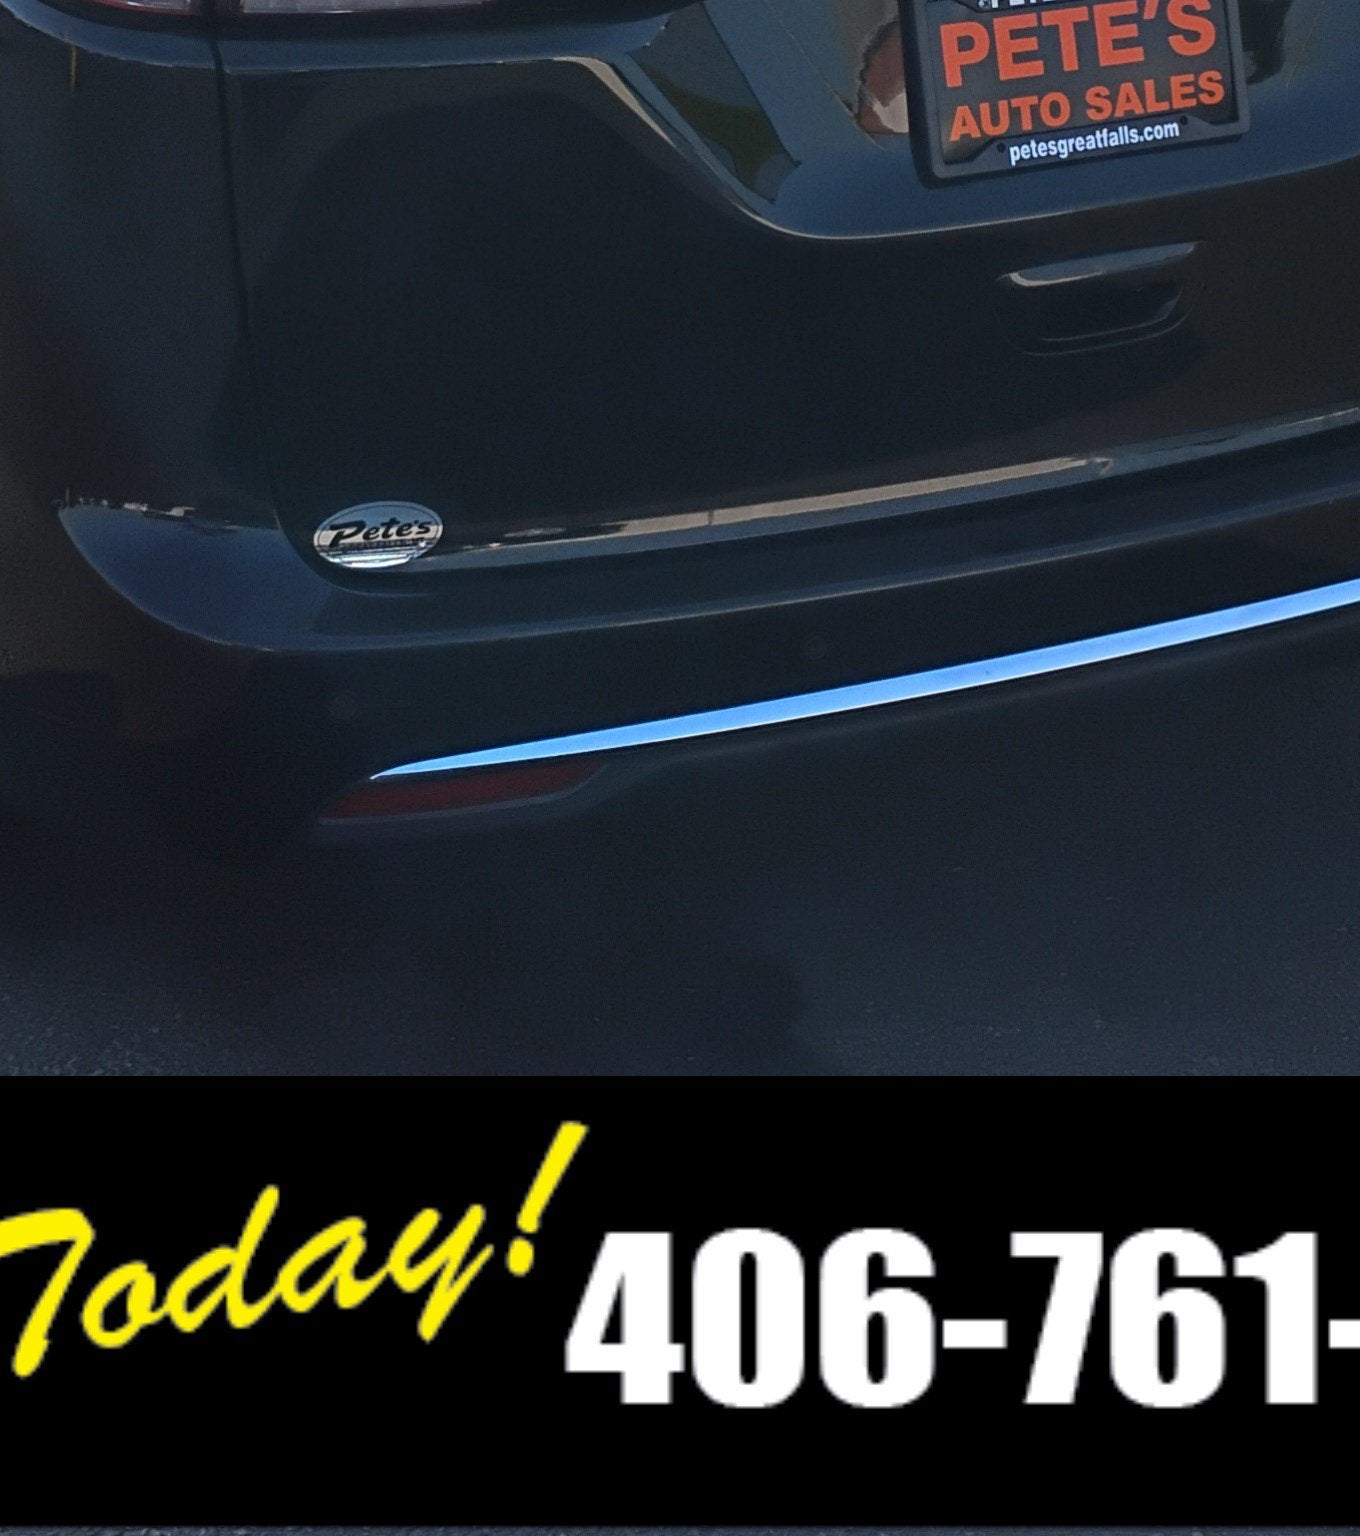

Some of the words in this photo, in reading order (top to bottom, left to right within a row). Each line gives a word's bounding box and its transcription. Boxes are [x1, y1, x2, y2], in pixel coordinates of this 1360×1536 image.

[949, 92, 1071, 141] AUTO
[1084, 70, 1225, 121] SALES
[1009, 120, 1180, 166] petesgreatfalls.com
[329, 517, 432, 548] Pete's
